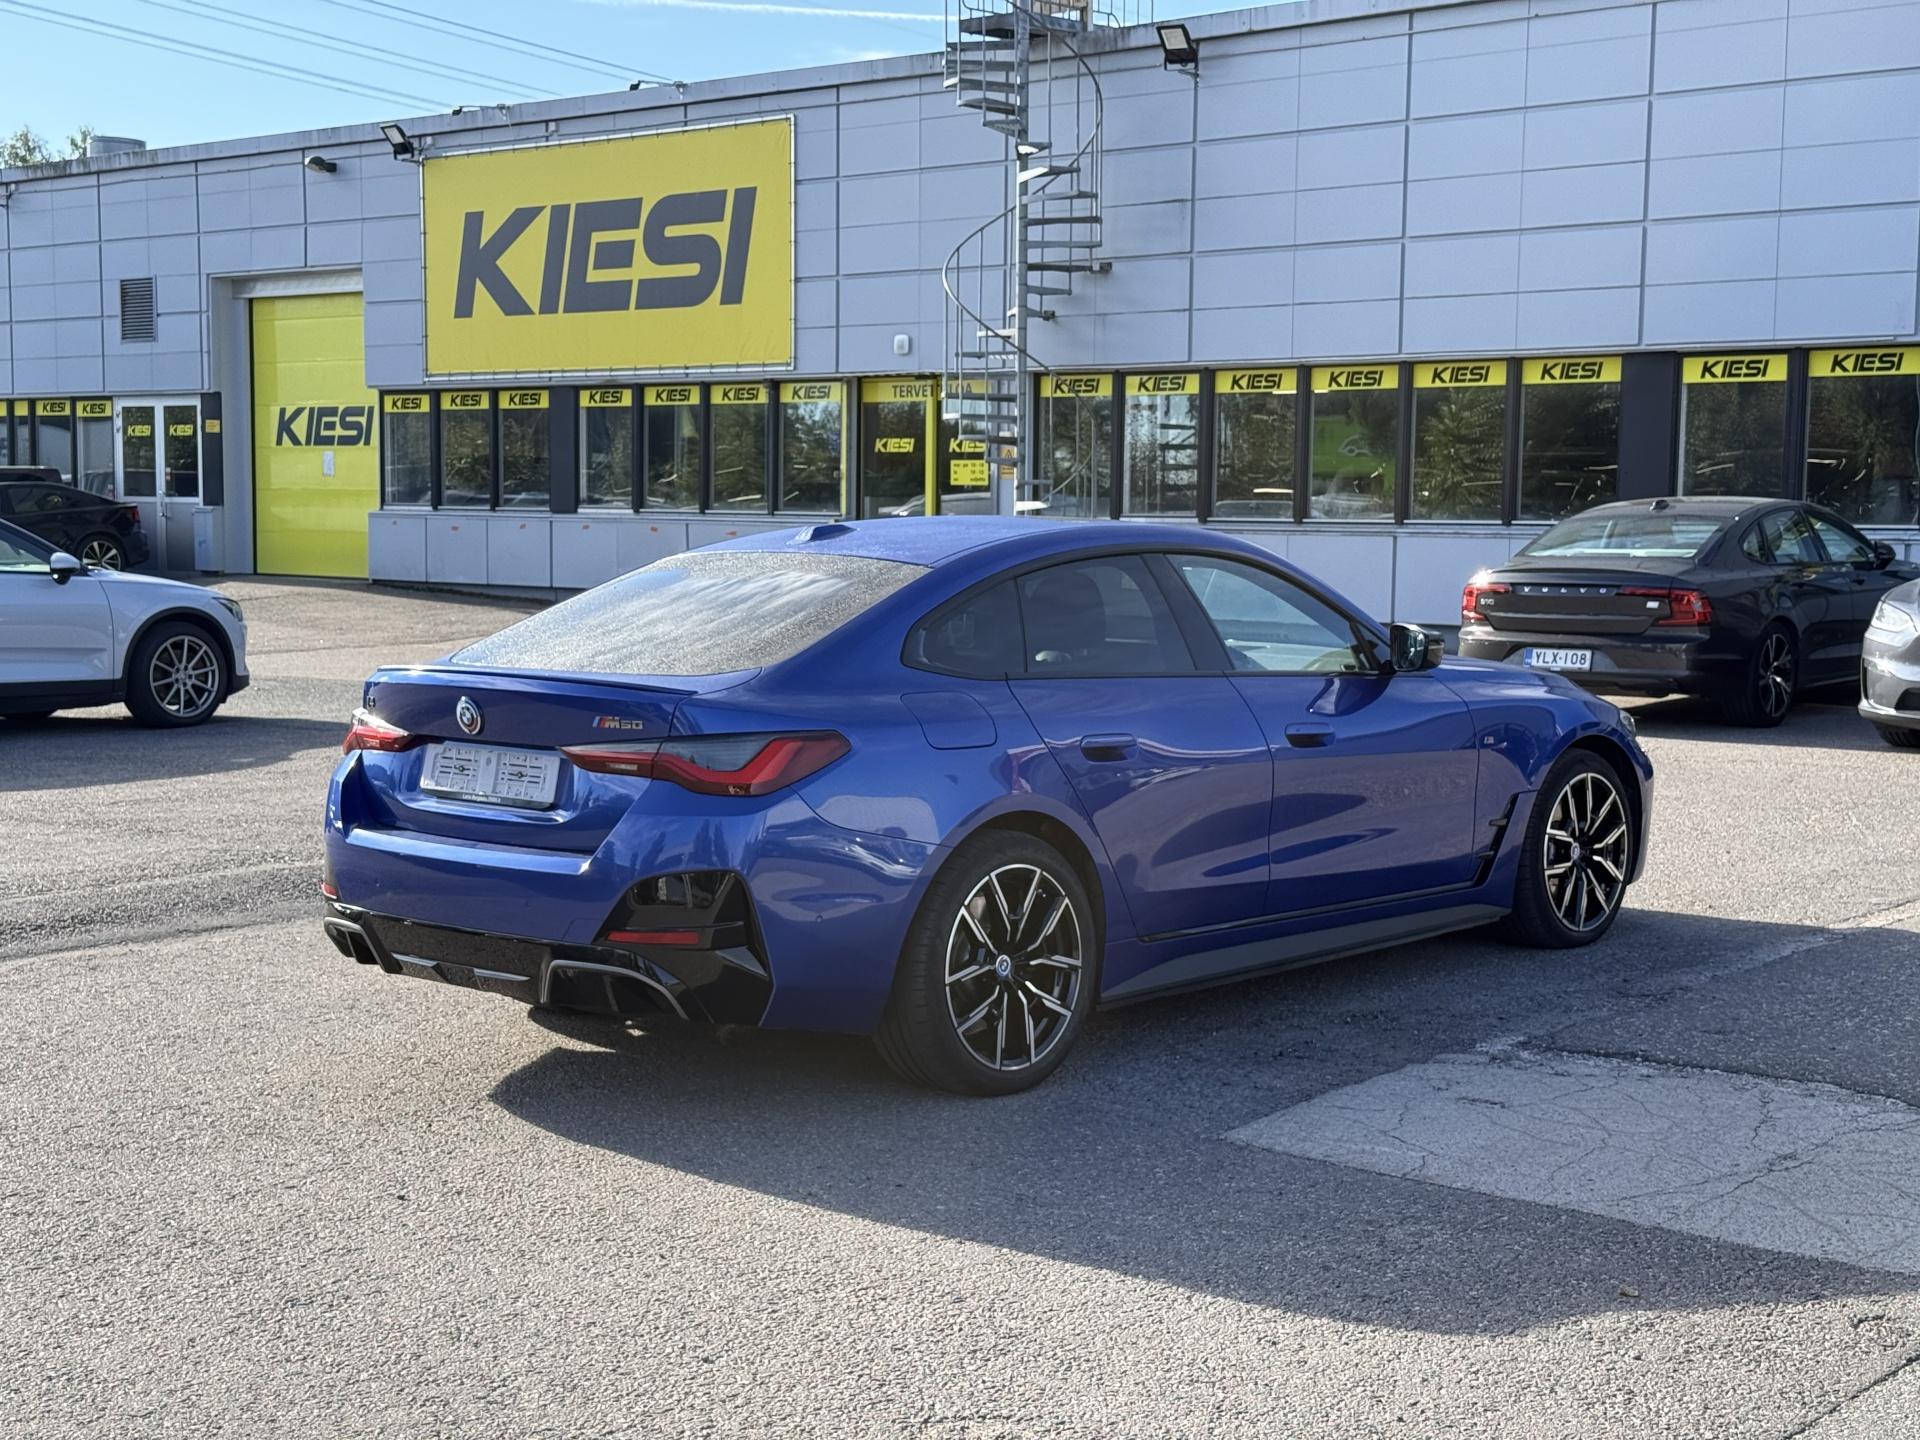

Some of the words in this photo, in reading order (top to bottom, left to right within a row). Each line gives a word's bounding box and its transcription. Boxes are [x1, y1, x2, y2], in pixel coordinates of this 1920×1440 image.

[454, 186, 758, 318] KIESI
[1699, 358, 1769, 379] KIESI
[1831, 352, 1905, 373] KIESI
[1327, 369, 1384, 388] KIESI
[1431, 364, 1491, 384] KIESI
[1540, 361, 1604, 381] KIESI
[1053, 377, 1101, 394] KIESI
[1137, 375, 1187, 392] KIESI
[1230, 372, 1283, 391] KIESI
[508, 391, 543, 406] KIESI
[588, 388, 623, 404] KIESI
[655, 387, 692, 403] KIESI
[721, 385, 760, 402] KIESI
[790, 383, 830, 400] KIESI
[42, 402, 66, 413] KIESI
[391, 396, 423, 410] KIESI
[450, 392, 483, 408] KIESI
[82, 403, 106, 414] KIESI
[127, 424, 152, 437] KIESI
[168, 424, 194, 437] KIESI
[276, 406, 375, 446] KIESI
[874, 438, 915, 453] KIESI
[949, 438, 989, 453] KIES
[1523, 586, 1607, 594] VOLVO
[1535, 651, 1587, 665] YLX-108
[600, 716, 643, 729] M50
